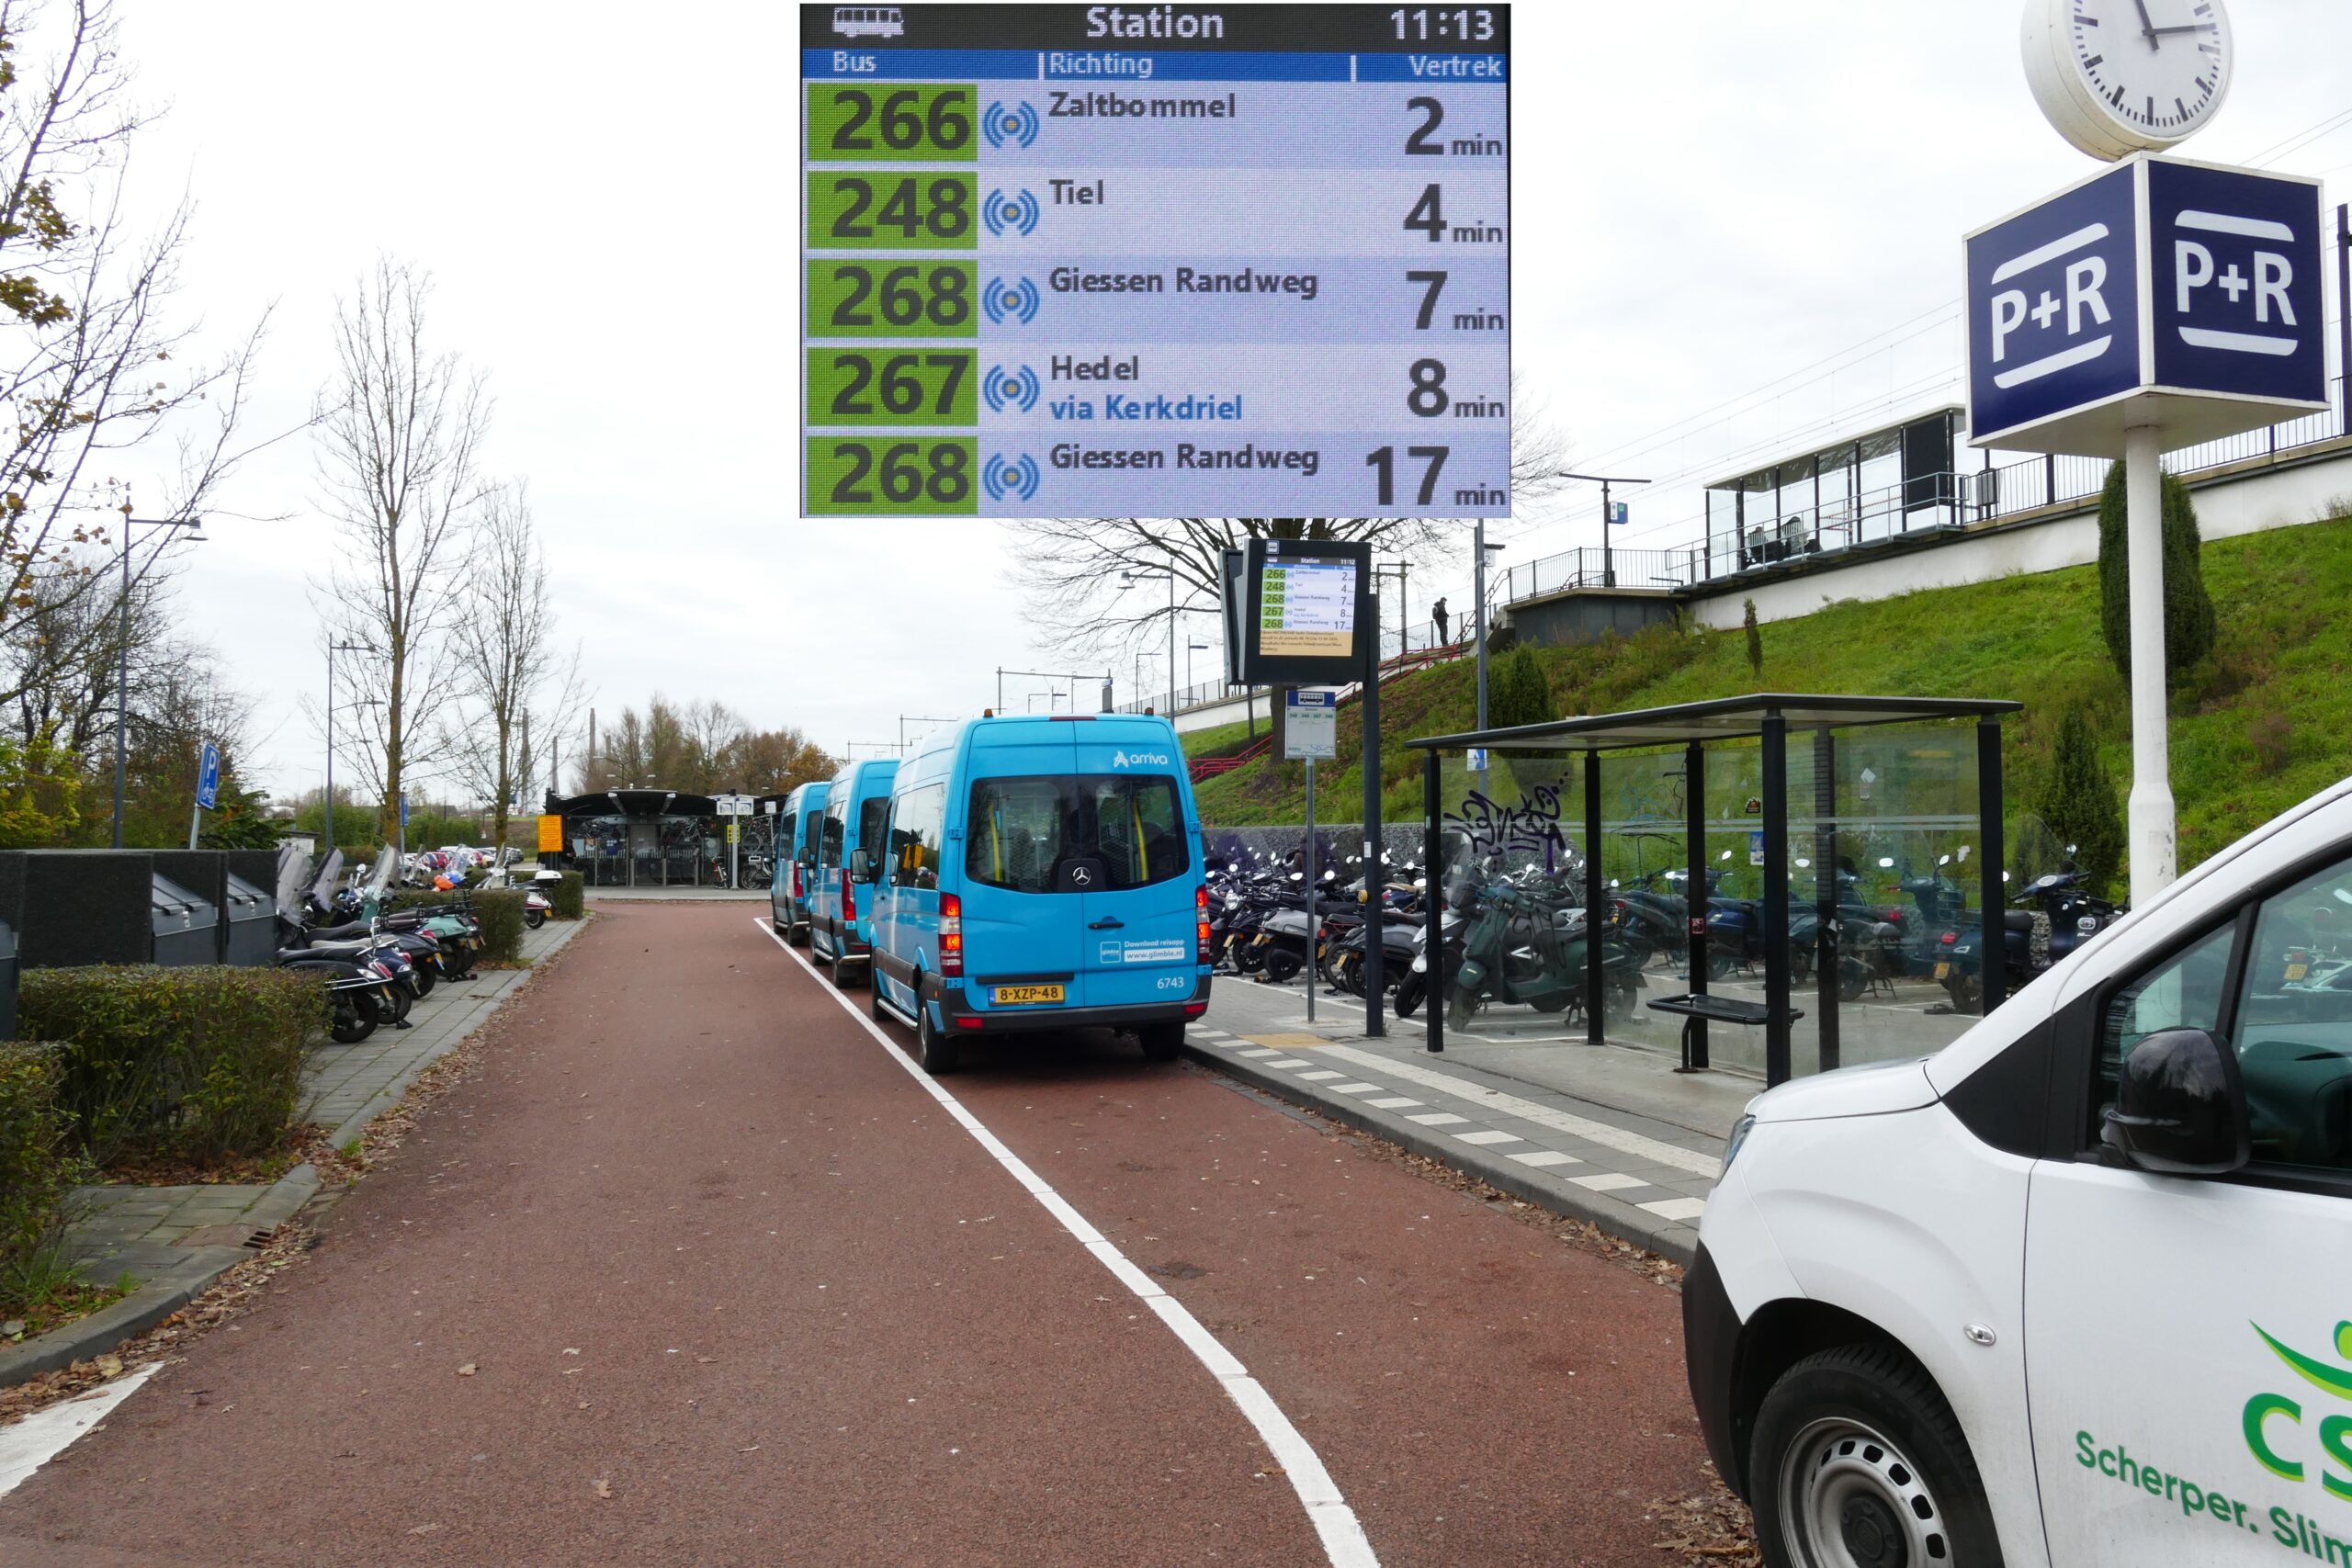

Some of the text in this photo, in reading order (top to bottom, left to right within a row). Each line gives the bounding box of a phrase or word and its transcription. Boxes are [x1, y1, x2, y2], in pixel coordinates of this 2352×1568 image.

[2175, 240, 2297, 326] P+R
[1991, 255, 2111, 363] P+R
[1267, 570, 1285, 579] 266
[1266, 581, 1285, 591] 248
[1266, 594, 1284, 604] 268
[1265, 606, 1283, 615] 267
[1264, 619, 1283, 628] 268
[1334, 621, 1346, 630] 17
[1130, 752, 1168, 765] arriva
[207, 750, 217, 779] P
[1124, 938, 1184, 948] Download reisapp
[1157, 976, 1184, 989] 6743
[1000, 987, 1058, 1000] 8-XZP-48
[2075, 1430, 2258, 1534] Scherper.
